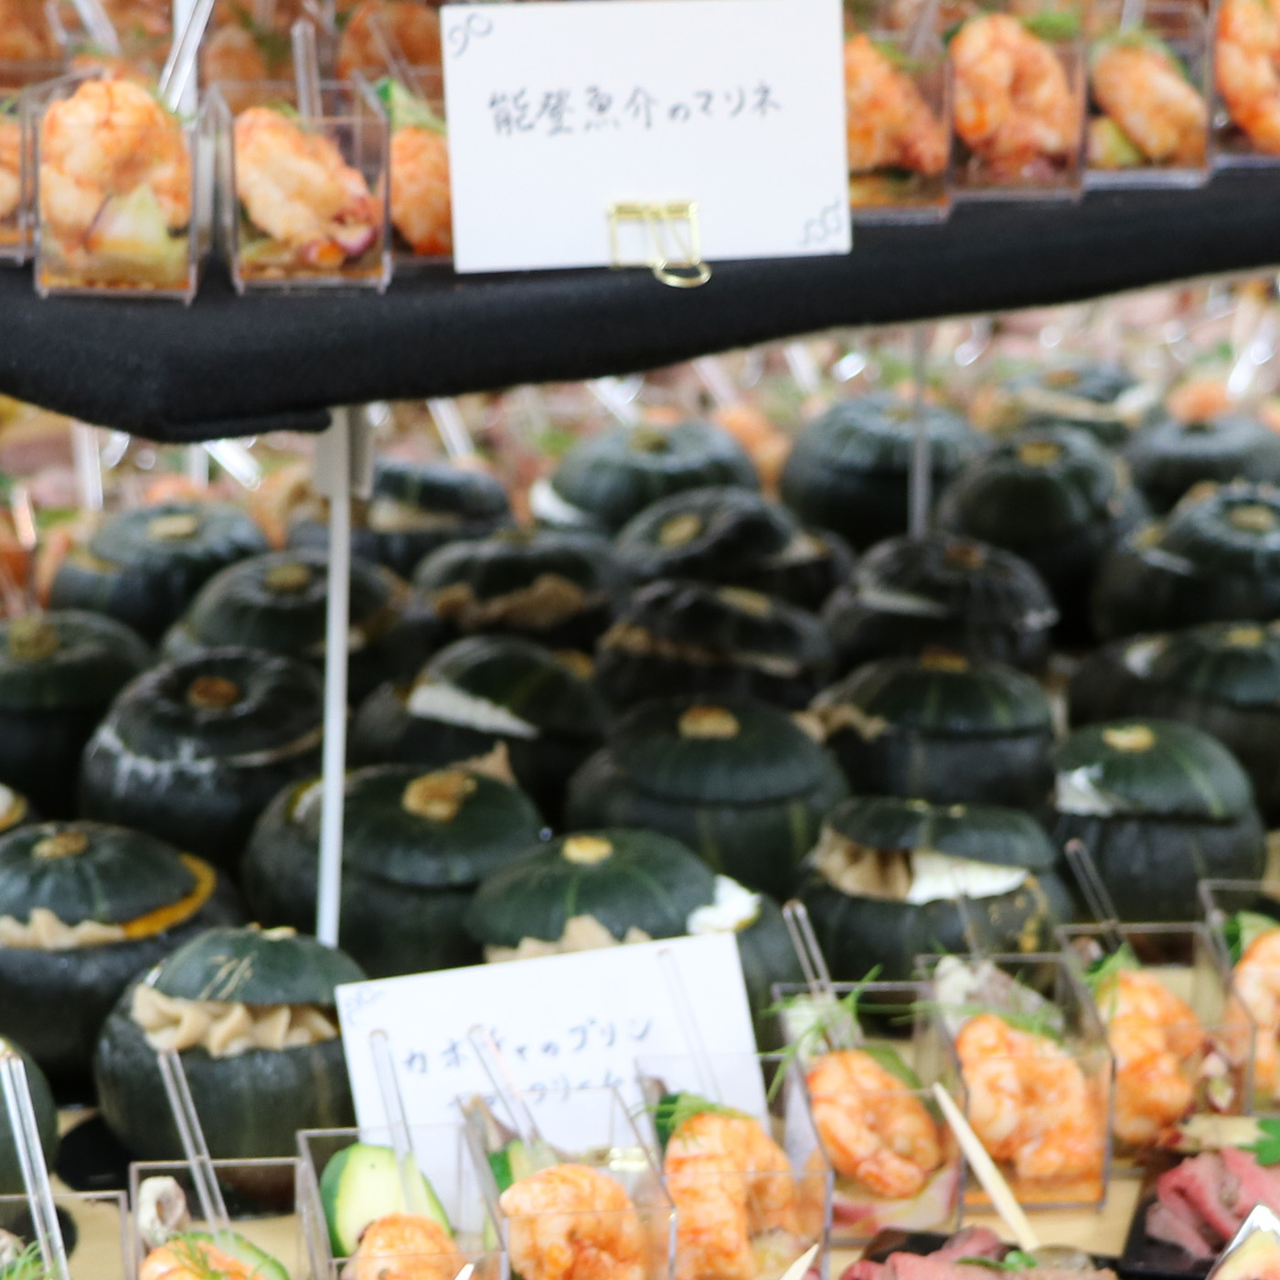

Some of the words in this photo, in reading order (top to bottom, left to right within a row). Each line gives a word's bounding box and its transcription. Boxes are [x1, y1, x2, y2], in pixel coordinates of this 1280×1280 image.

[488, 81, 781, 136] 能登魚介のマリネ
